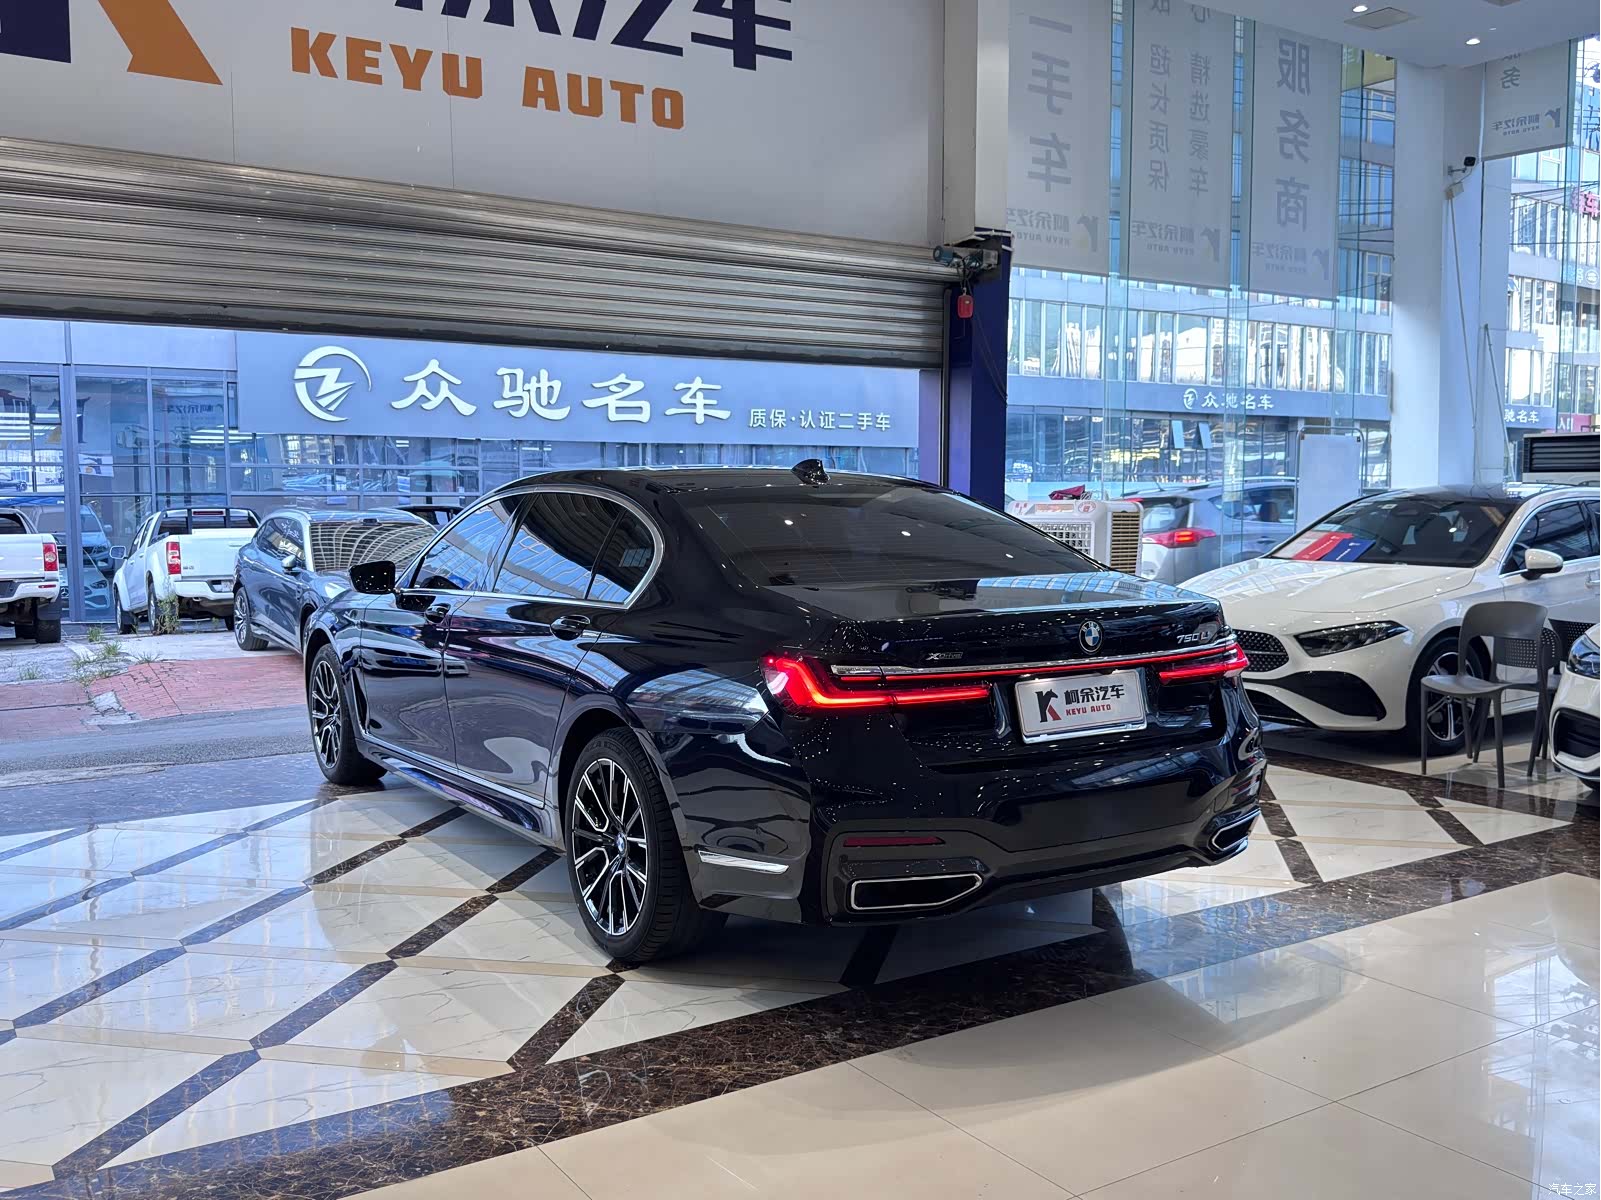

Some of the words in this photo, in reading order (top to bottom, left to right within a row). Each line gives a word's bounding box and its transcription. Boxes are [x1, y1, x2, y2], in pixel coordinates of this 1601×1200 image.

[291, 27, 482, 99] KEYU
[522, 66, 684, 129] AUTO
[391, 357, 732, 425] 众驰名车
[1201, 392, 1274, 410] 众驰名车
[749, 408, 892, 431] 质保·认证二手车
[1064, 684, 1125, 705] 柯余汽车
[1065, 707, 1087, 716] KEYU
[1090, 703, 1111, 713] AUTO
